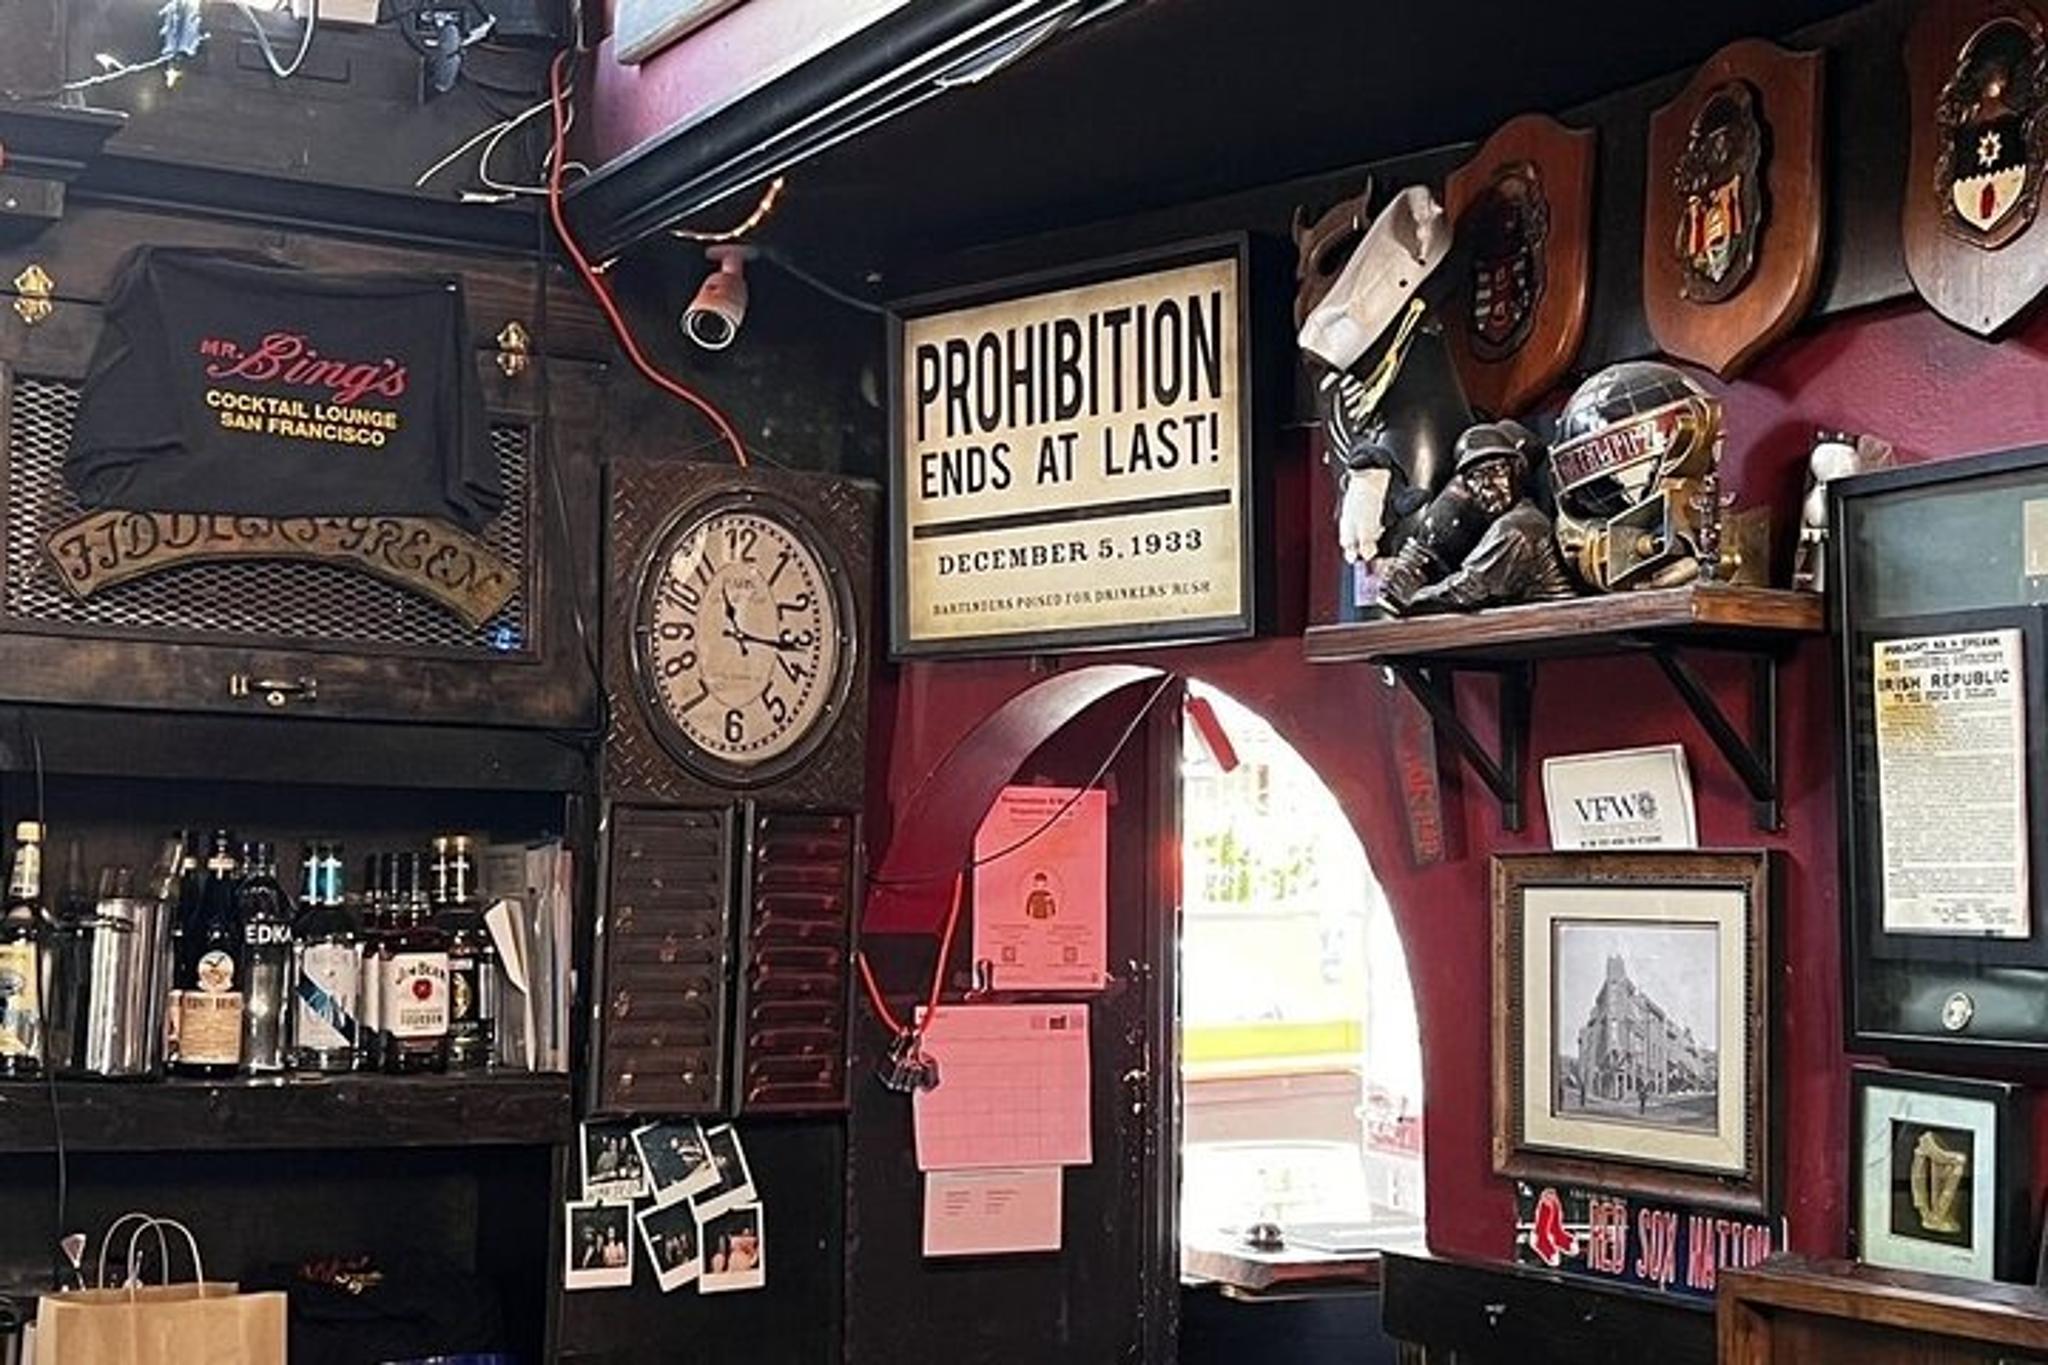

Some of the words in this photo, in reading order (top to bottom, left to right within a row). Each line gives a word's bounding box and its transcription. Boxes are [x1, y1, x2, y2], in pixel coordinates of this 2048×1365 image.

[201, 340, 244, 359] MR.
[916, 290, 1222, 442] PROHIBITION
[206, 333, 408, 404] Bing's
[206, 389, 310, 420] COCKTAIL
[315, 404, 397, 430] LOUNGE
[220, 412, 263, 432] SAN
[268, 418, 386, 447] FRANCISCO
[920, 442, 1012, 499] ENDS
[1037, 432, 1079, 485] AT
[1104, 412, 1220, 477] LAST!
[725, 527, 757, 563] 12
[938, 540, 1089, 576] DECEMBER
[768, 552, 789, 588] 1
[665, 577, 700, 616] 10
[776, 593, 810, 621] 2
[1066, 591, 1092, 605] FOR
[660, 621, 695, 641] 9
[664, 650, 697, 678] 8
[775, 653, 808, 684] 4
[1878, 676, 1922, 692] IRISH
[1931, 669, 2010, 689] REPUBLIC
[680, 678, 710, 715] 7
[761, 681, 786, 724] 5
[724, 708, 744, 743] 6
[1574, 792, 1638, 822] VFW
[1587, 1198, 1627, 1275] RED
[1635, 1207, 1678, 1284] SOX
